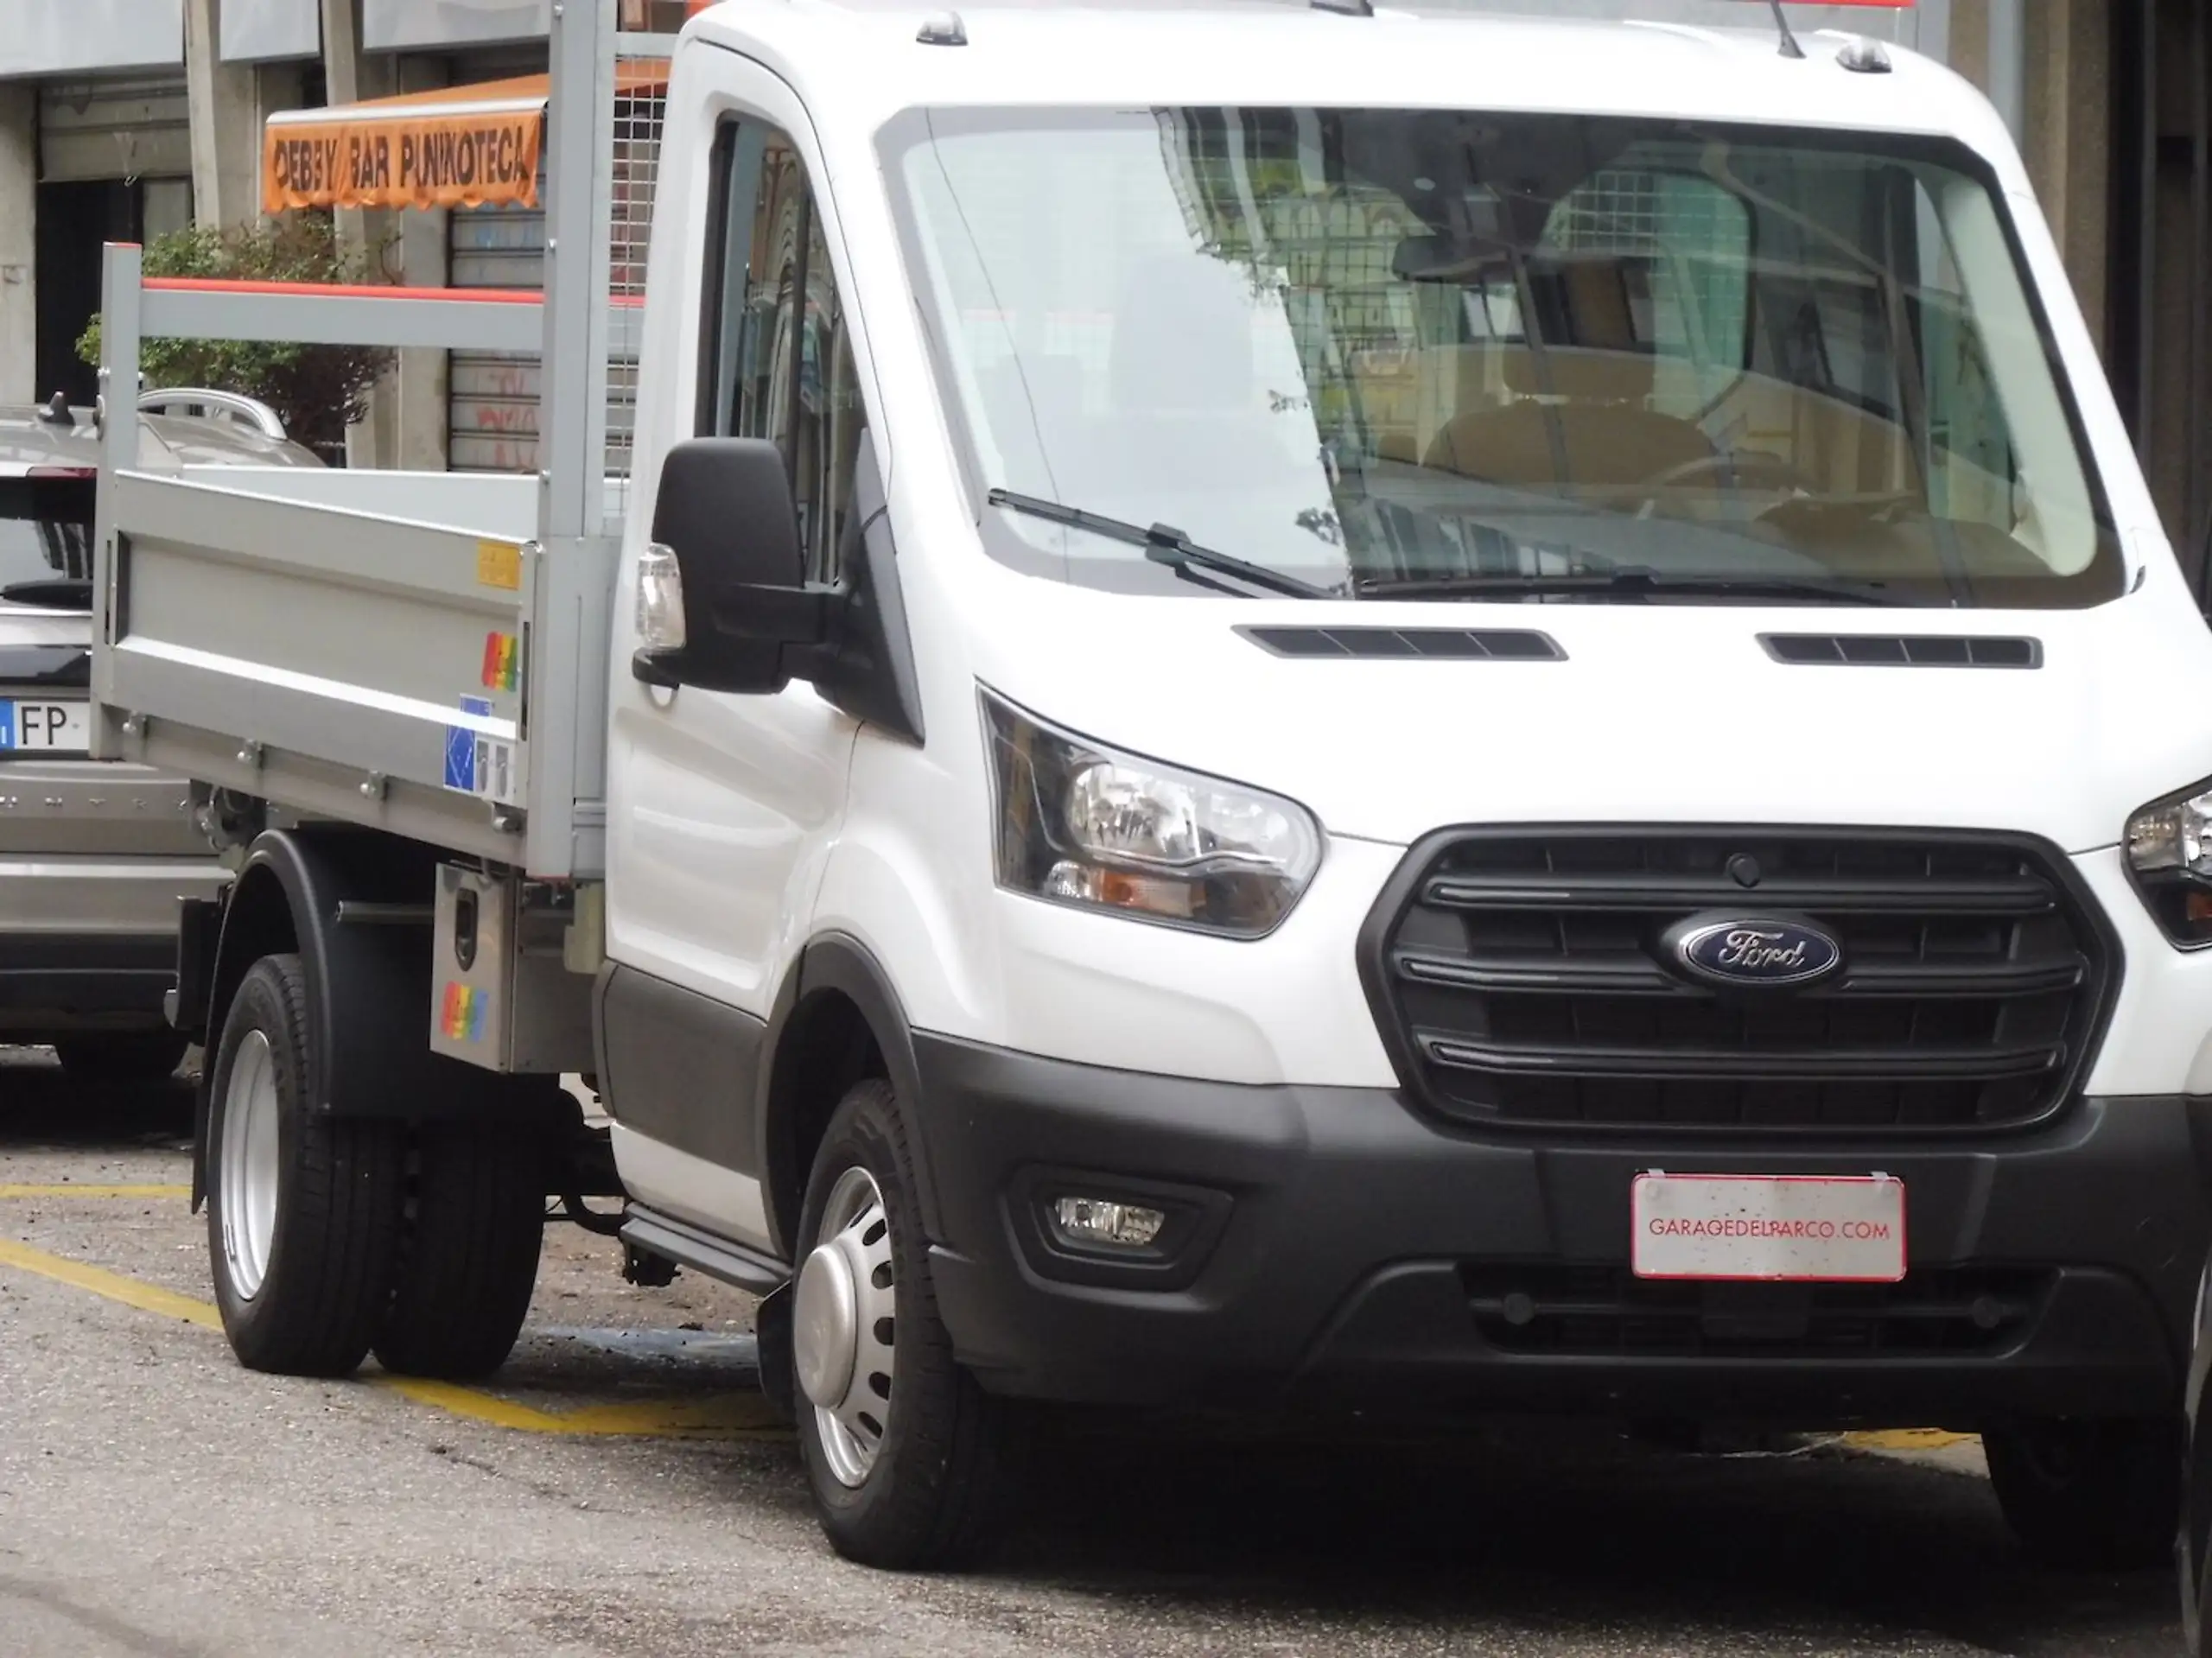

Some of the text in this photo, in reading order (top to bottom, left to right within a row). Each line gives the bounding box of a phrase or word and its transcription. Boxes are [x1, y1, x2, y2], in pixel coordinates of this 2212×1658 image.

[349, 133, 391, 188] BAR
[21, 706, 67, 745] FP
[1718, 930, 1807, 968] Ford
[1649, 1218, 1890, 1239] GARAGEDELPARCO.COM
